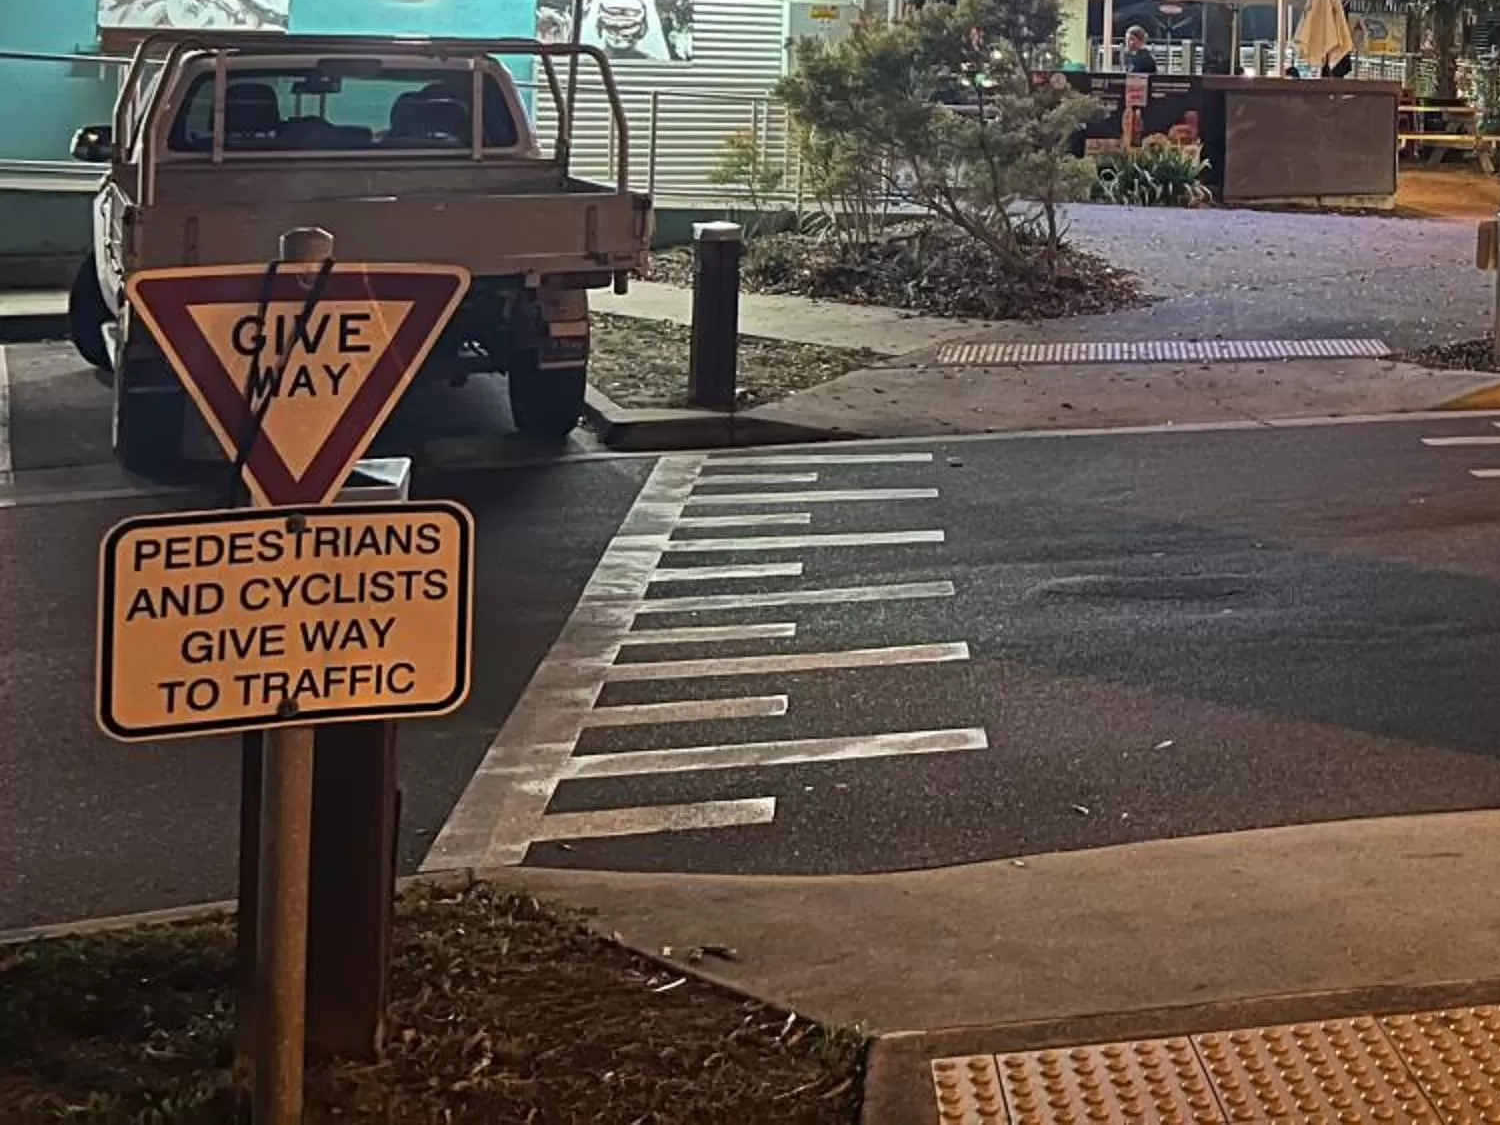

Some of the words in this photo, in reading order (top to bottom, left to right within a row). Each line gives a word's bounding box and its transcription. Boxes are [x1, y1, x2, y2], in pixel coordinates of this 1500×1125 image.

[231, 312, 372, 356] GIVE
[249, 362, 352, 398] WAY
[133, 523, 441, 572] PEDESTRIANS
[126, 581, 225, 622] AND
[239, 569, 449, 611] CYCLISTS
[181, 624, 286, 664] GIVE
[300, 617, 397, 653] WAY
[157, 677, 220, 715] TO
[234, 662, 416, 706] TRAFFIC
